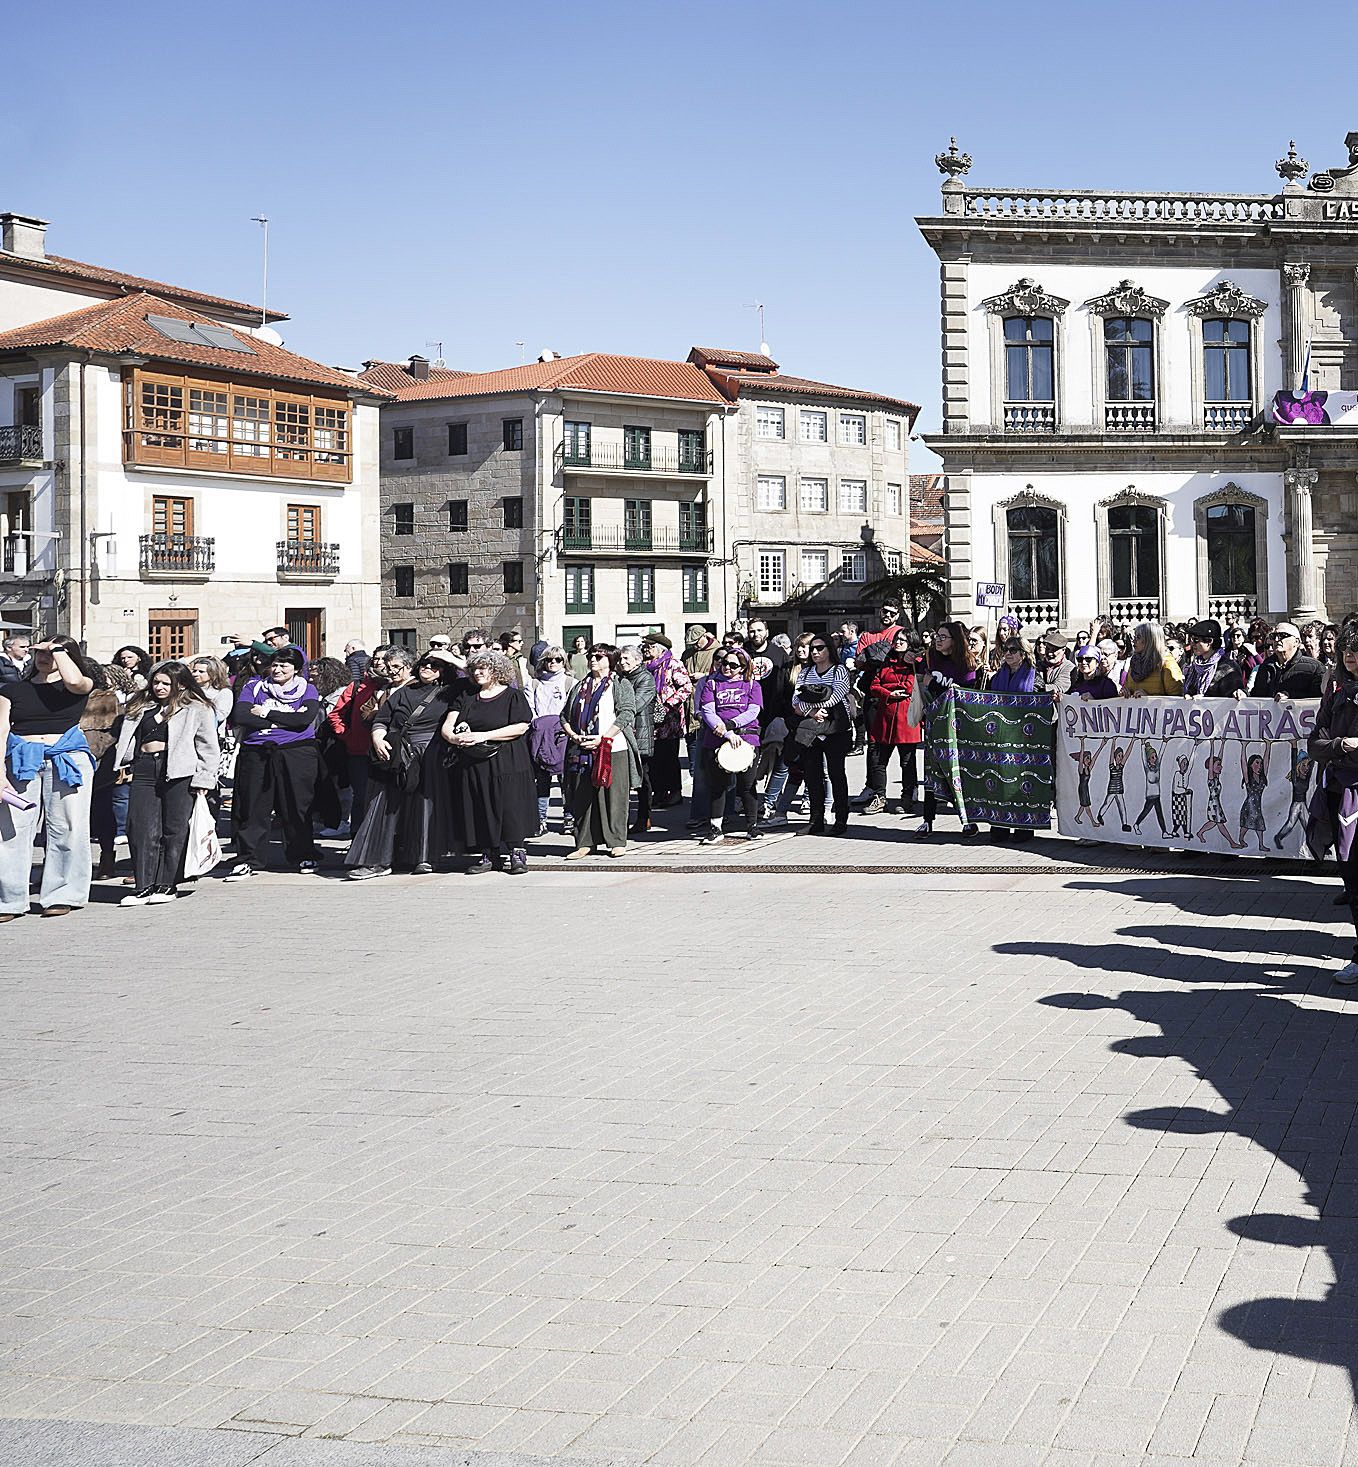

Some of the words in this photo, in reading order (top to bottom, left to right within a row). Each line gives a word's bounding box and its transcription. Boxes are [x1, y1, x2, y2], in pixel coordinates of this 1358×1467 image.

[1341, 403, 1357, 412] que
[985, 584, 1004, 595] BODY
[1161, 708, 1214, 738] PASO
[1223, 705, 1316, 740] ATRÁS
